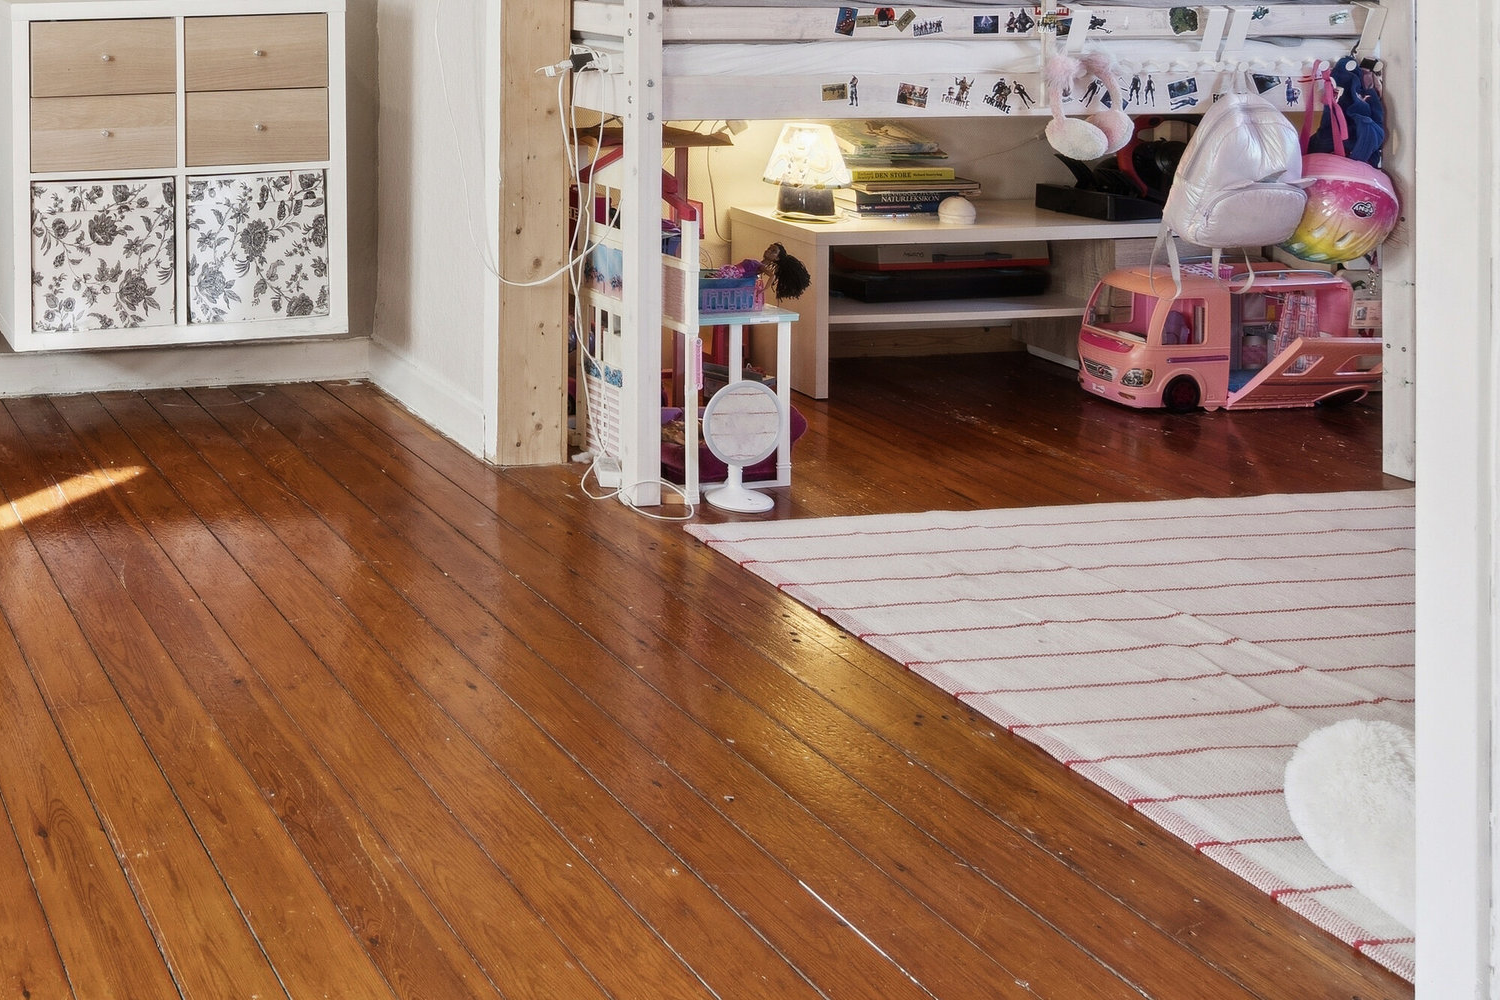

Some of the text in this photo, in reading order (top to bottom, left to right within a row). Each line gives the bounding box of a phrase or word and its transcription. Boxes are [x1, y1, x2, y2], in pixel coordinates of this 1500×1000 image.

[941, 93, 970, 110] FORTNITE
[983, 94, 1011, 115] FORTNITE
[881, 195, 940, 203] NATURLEKSIKON
